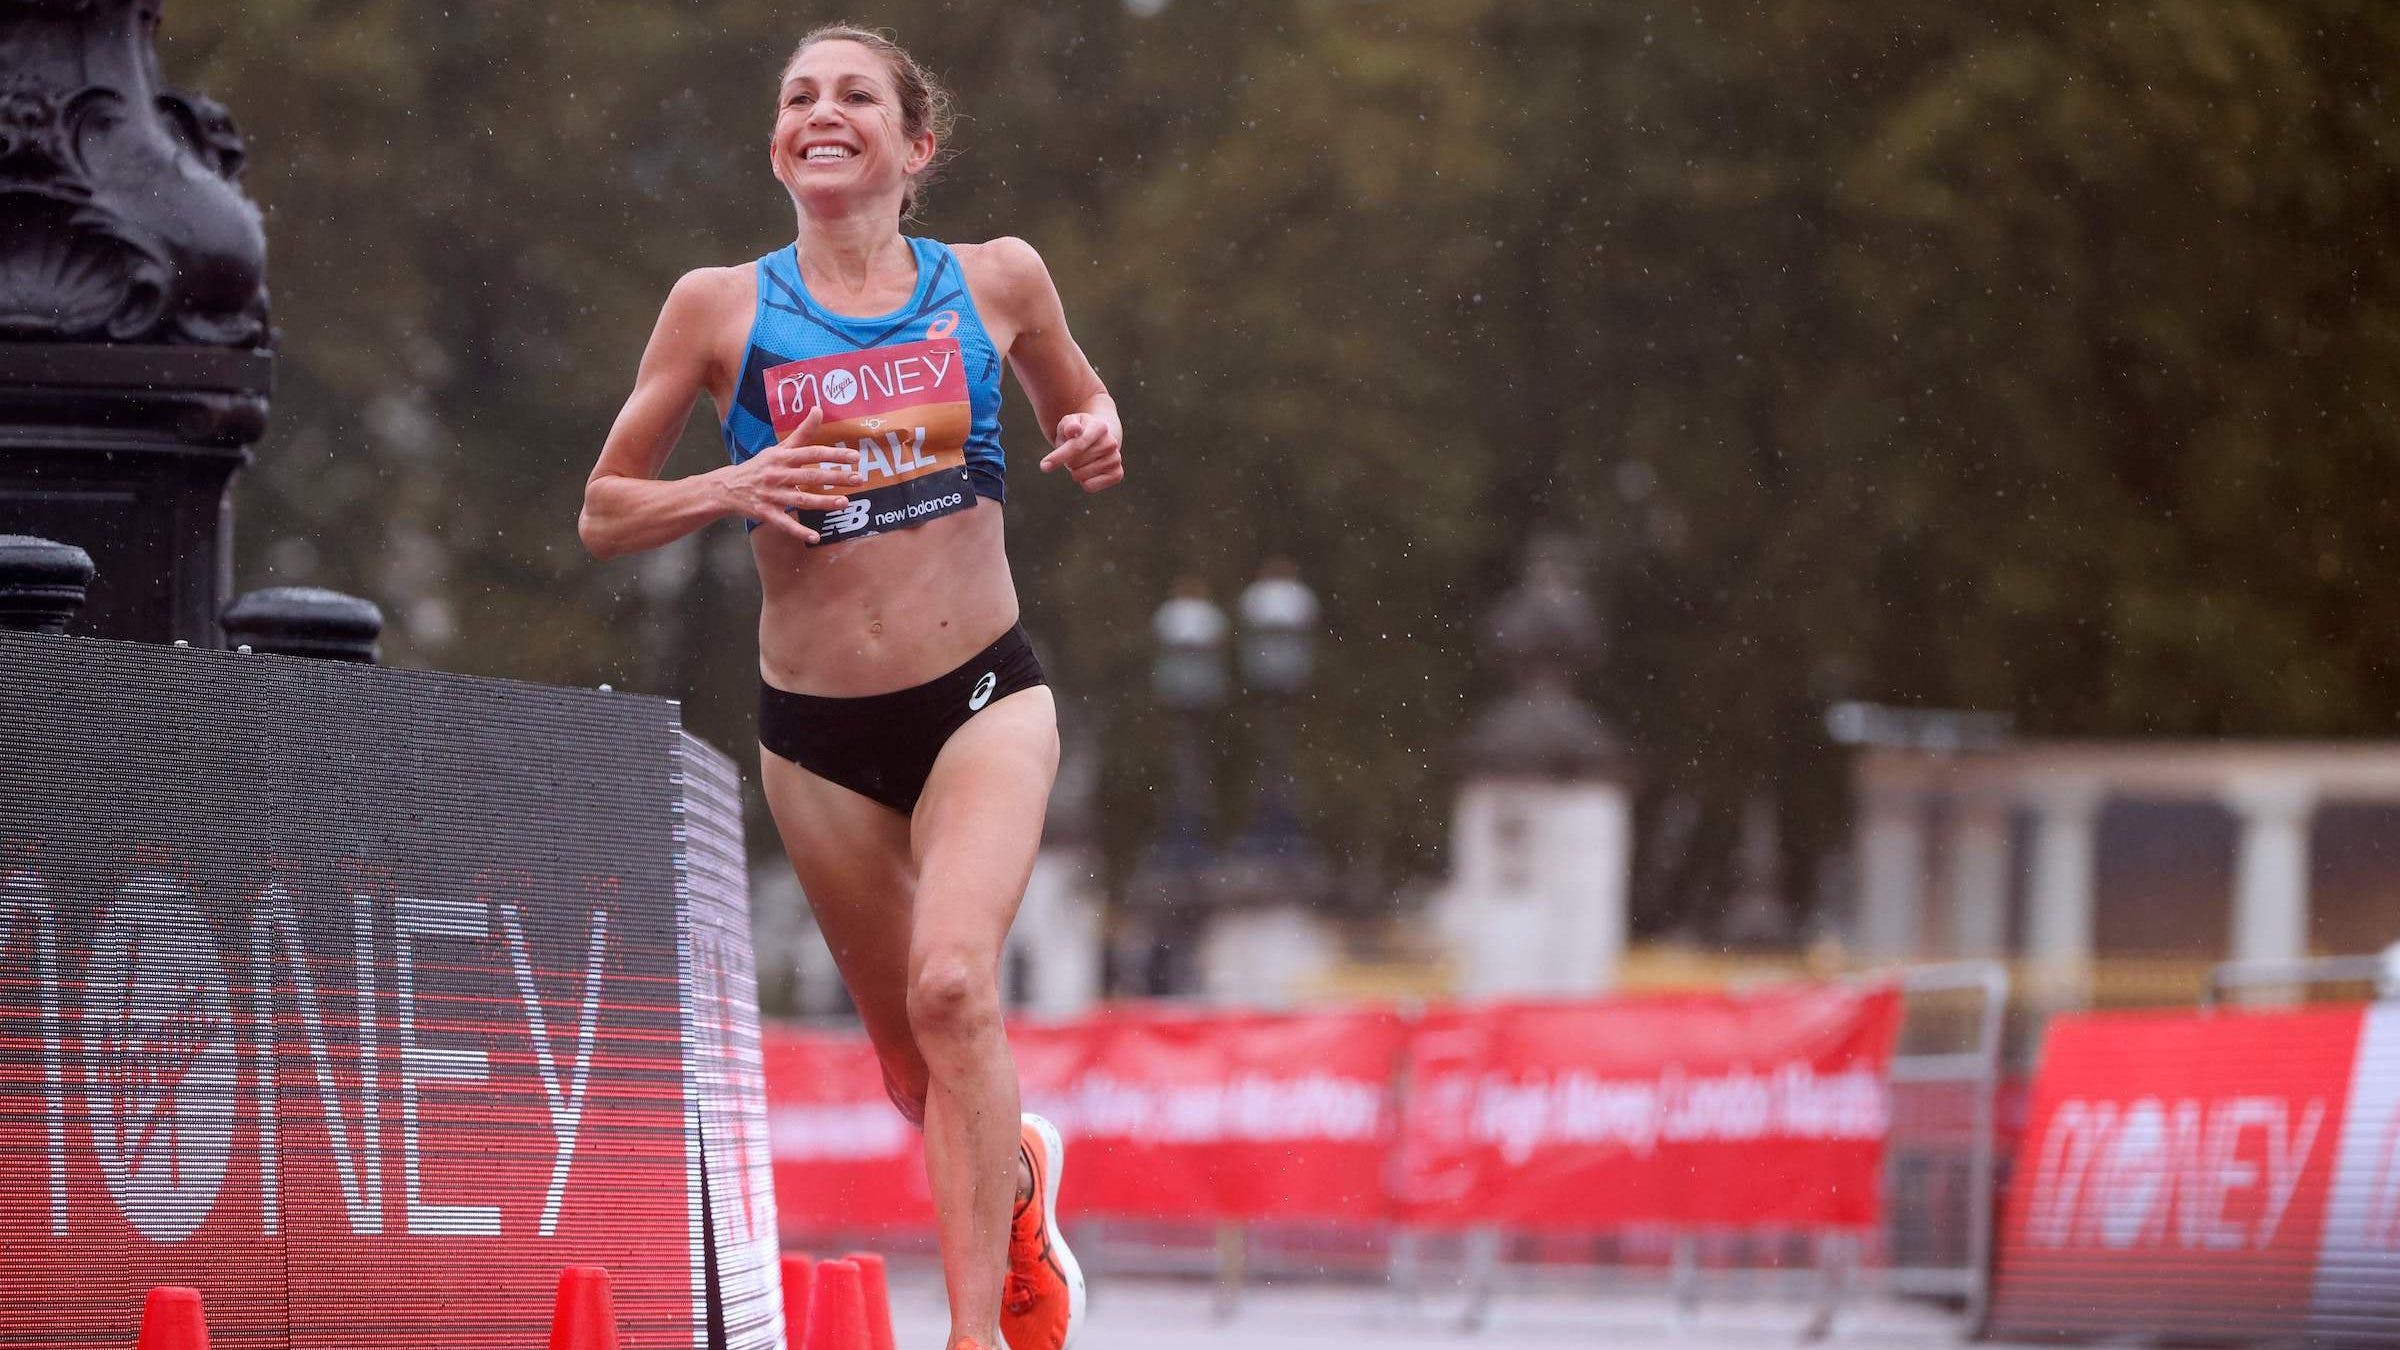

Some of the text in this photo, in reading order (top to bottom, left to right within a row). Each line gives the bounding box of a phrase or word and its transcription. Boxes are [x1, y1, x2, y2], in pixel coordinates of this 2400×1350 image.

[826, 374, 853, 399] Virgin
[875, 492, 962, 526] new balance
